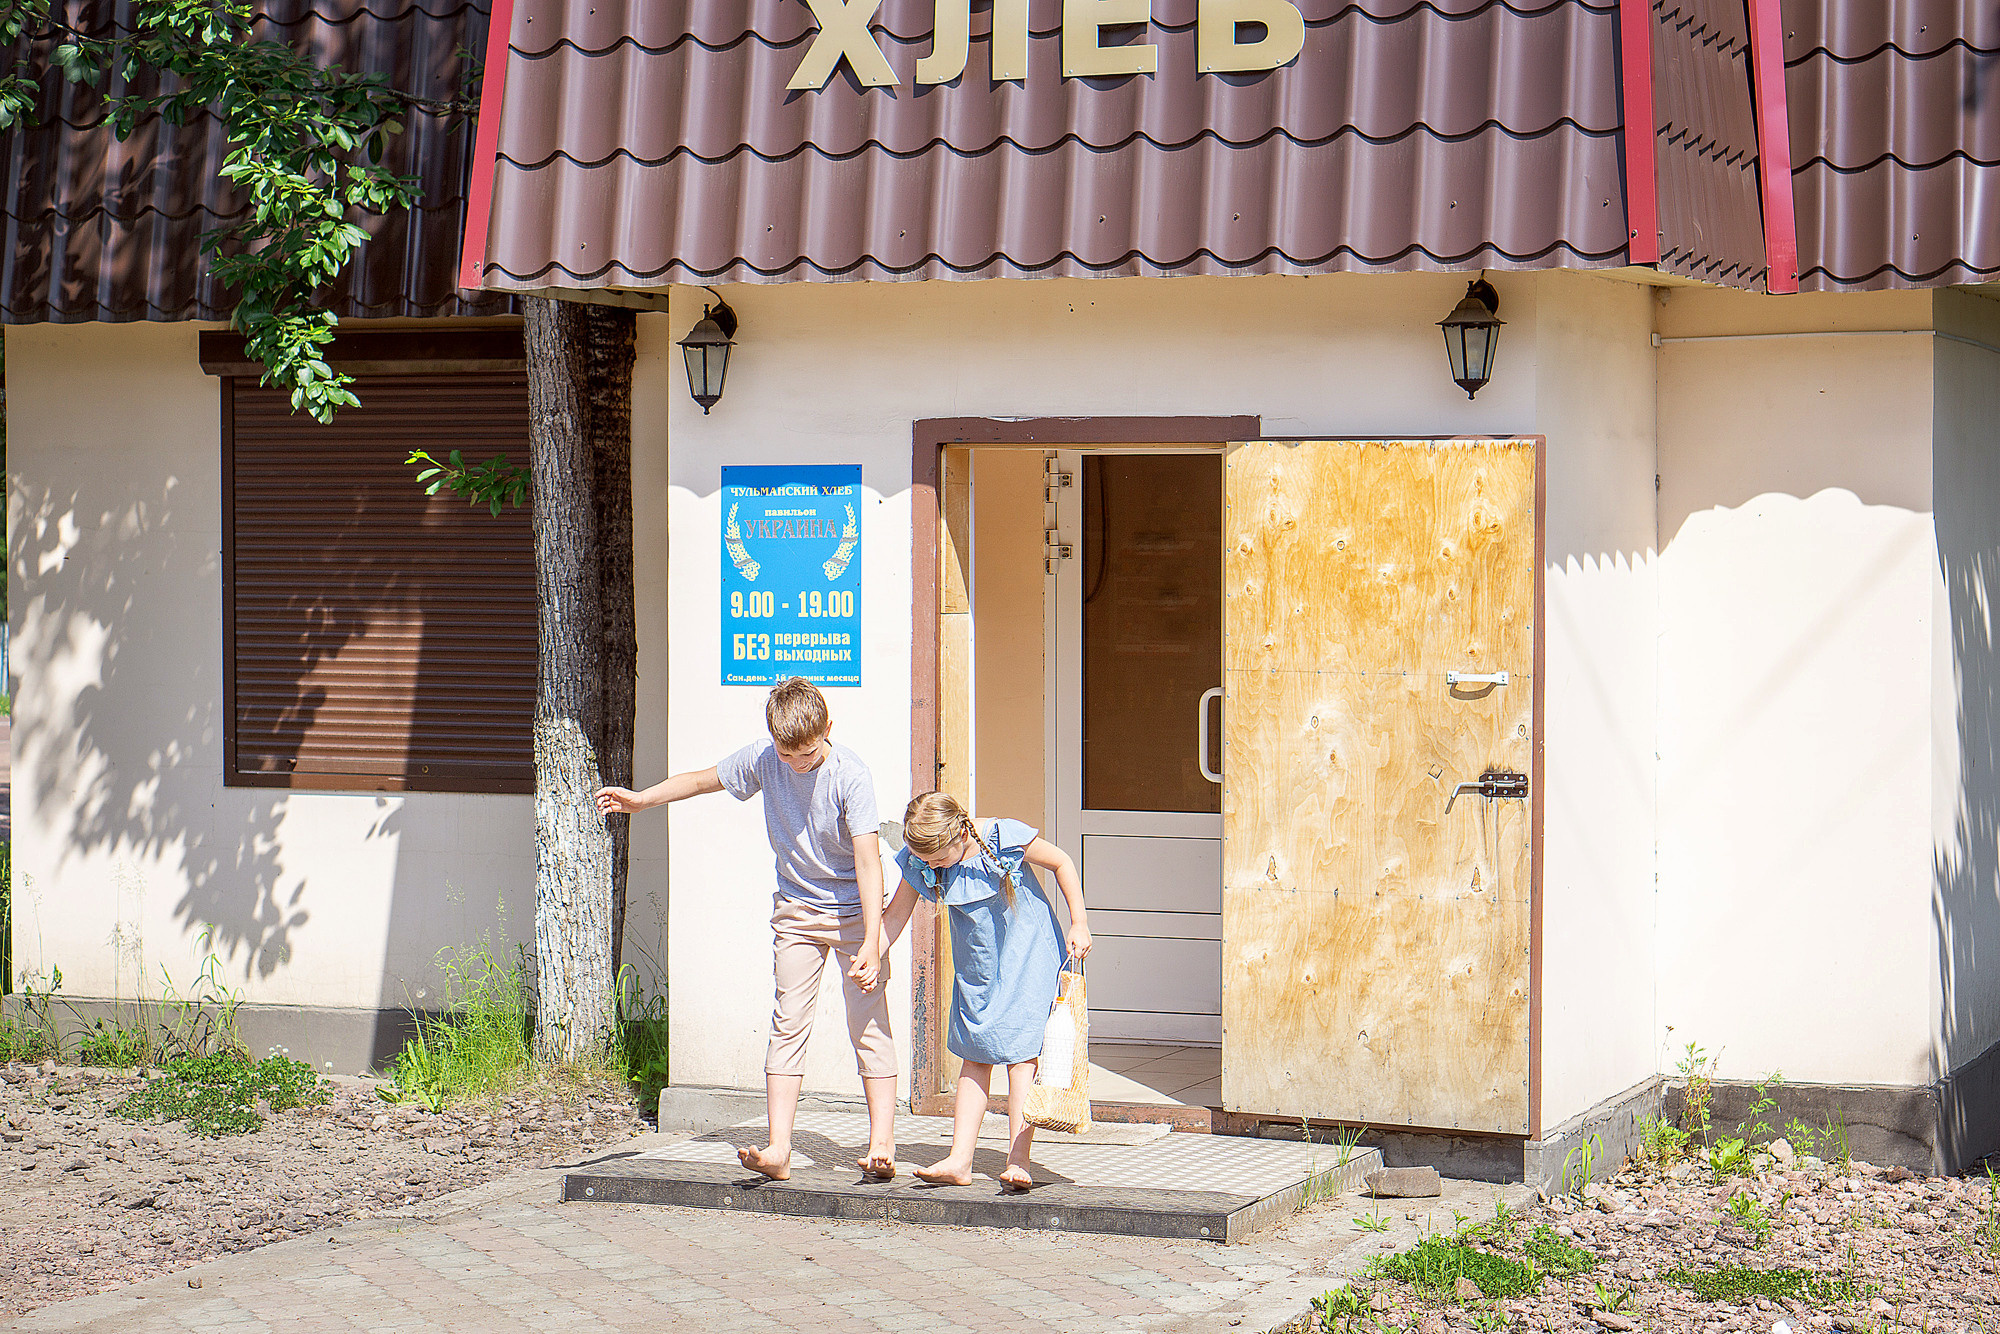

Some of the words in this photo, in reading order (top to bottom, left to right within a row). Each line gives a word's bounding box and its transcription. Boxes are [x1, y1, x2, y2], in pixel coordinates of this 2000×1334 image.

[730, 485, 818, 496] ЧУЛЬМАНСКИЙ
[821, 486, 853, 496] ХЛЕБ
[764, 508, 817, 517] павильон
[744, 519, 838, 539] УКРАИНА
[730, 591, 775, 618] 9.00
[797, 590, 854, 618] 19.00
[733, 633, 771, 660] БЕЗ
[774, 633, 851, 647] перерыва
[774, 649, 852, 663] выходных
[727, 673, 767, 682] Сан.день
[826, 675, 859, 683] месяца
